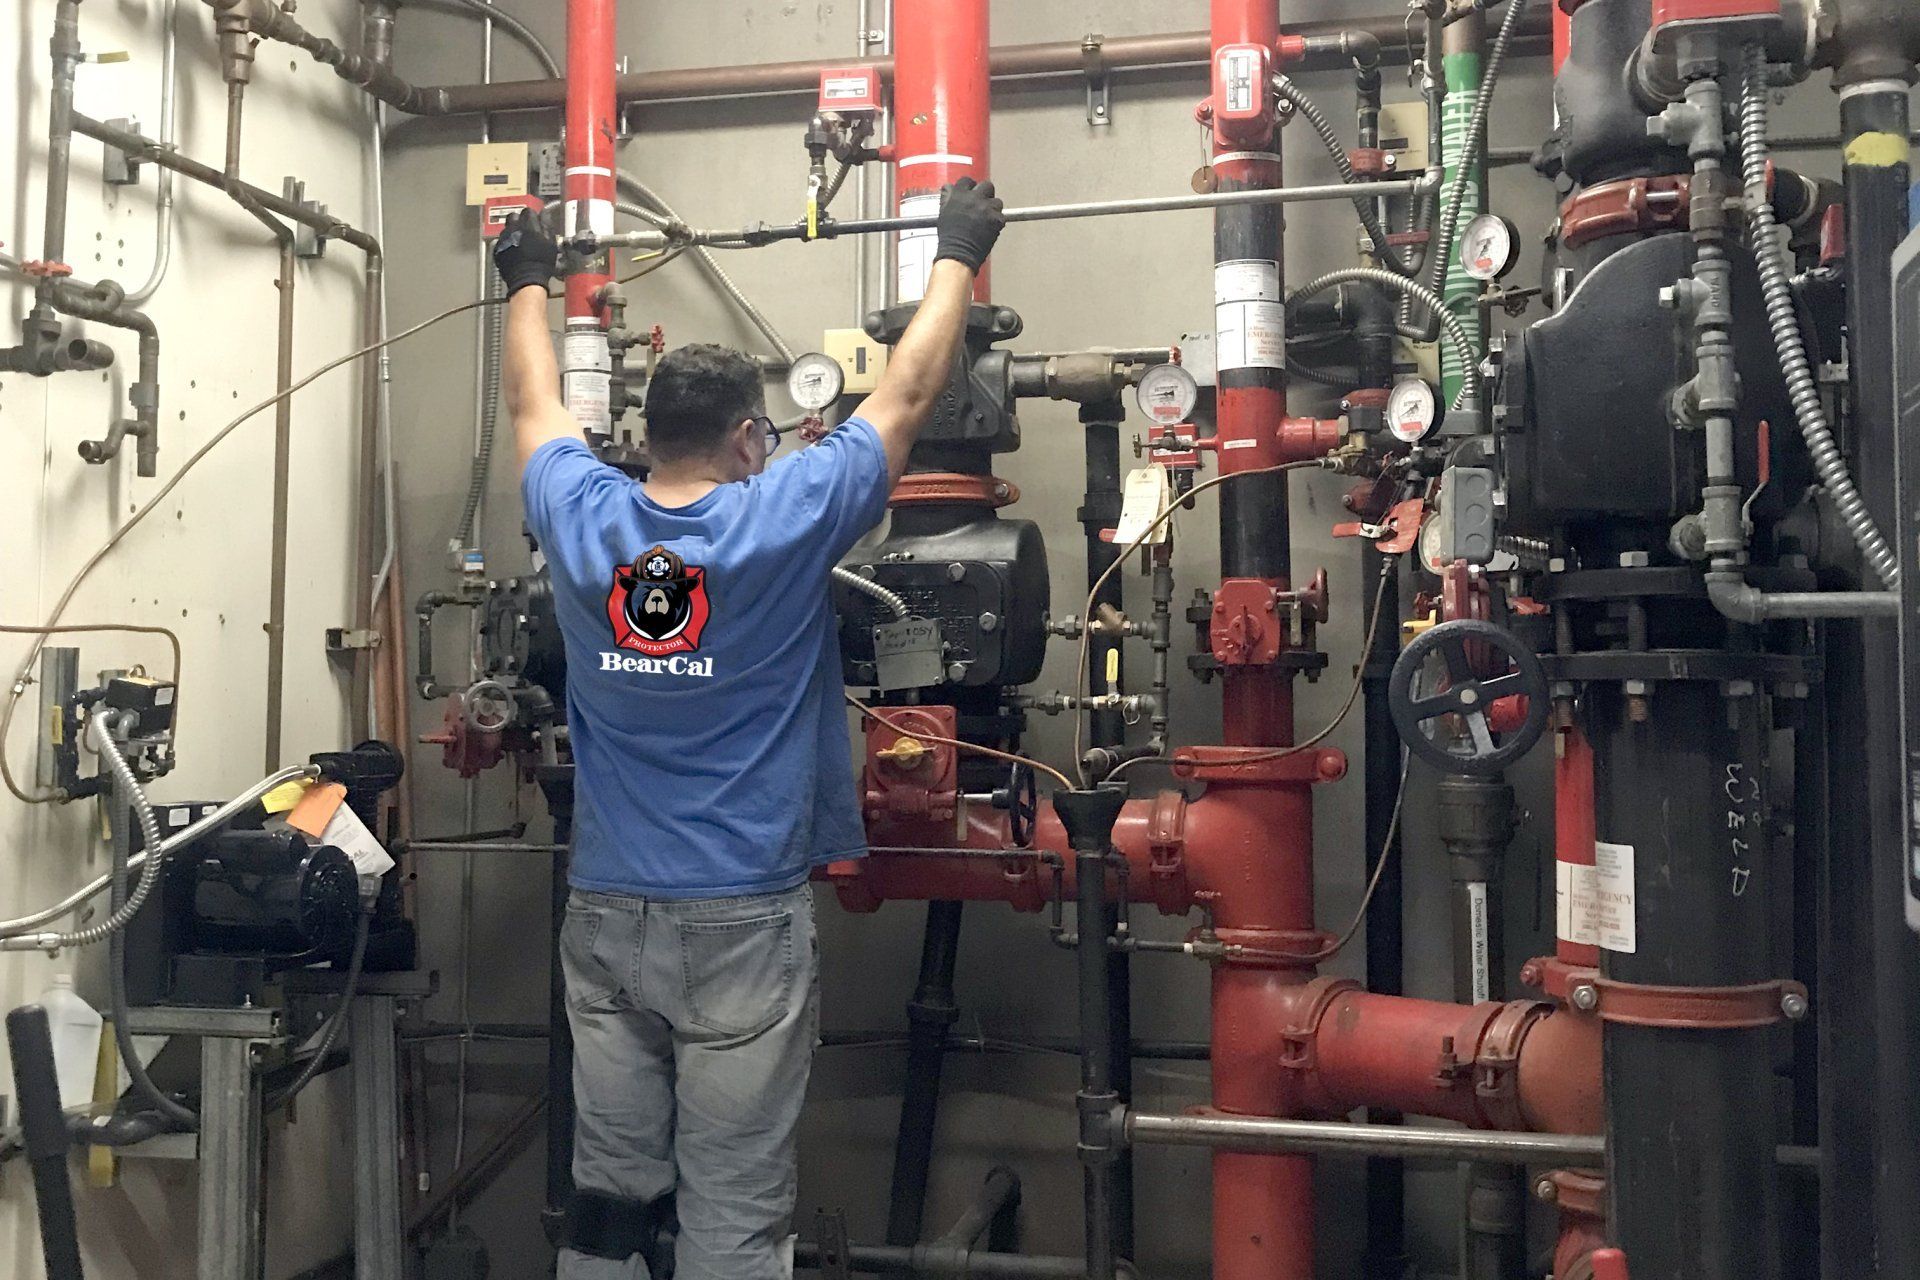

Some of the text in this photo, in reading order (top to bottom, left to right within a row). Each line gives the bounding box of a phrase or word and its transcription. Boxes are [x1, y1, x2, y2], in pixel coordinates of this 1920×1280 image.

[1441, 90, 1480, 169] WATER
[598, 651, 714, 677] BearCal
[627, 637, 685, 651] PROTECTOR
[1725, 763, 1751, 896] WELD
[1474, 897, 1486, 999] Domestic Water Shutoff
